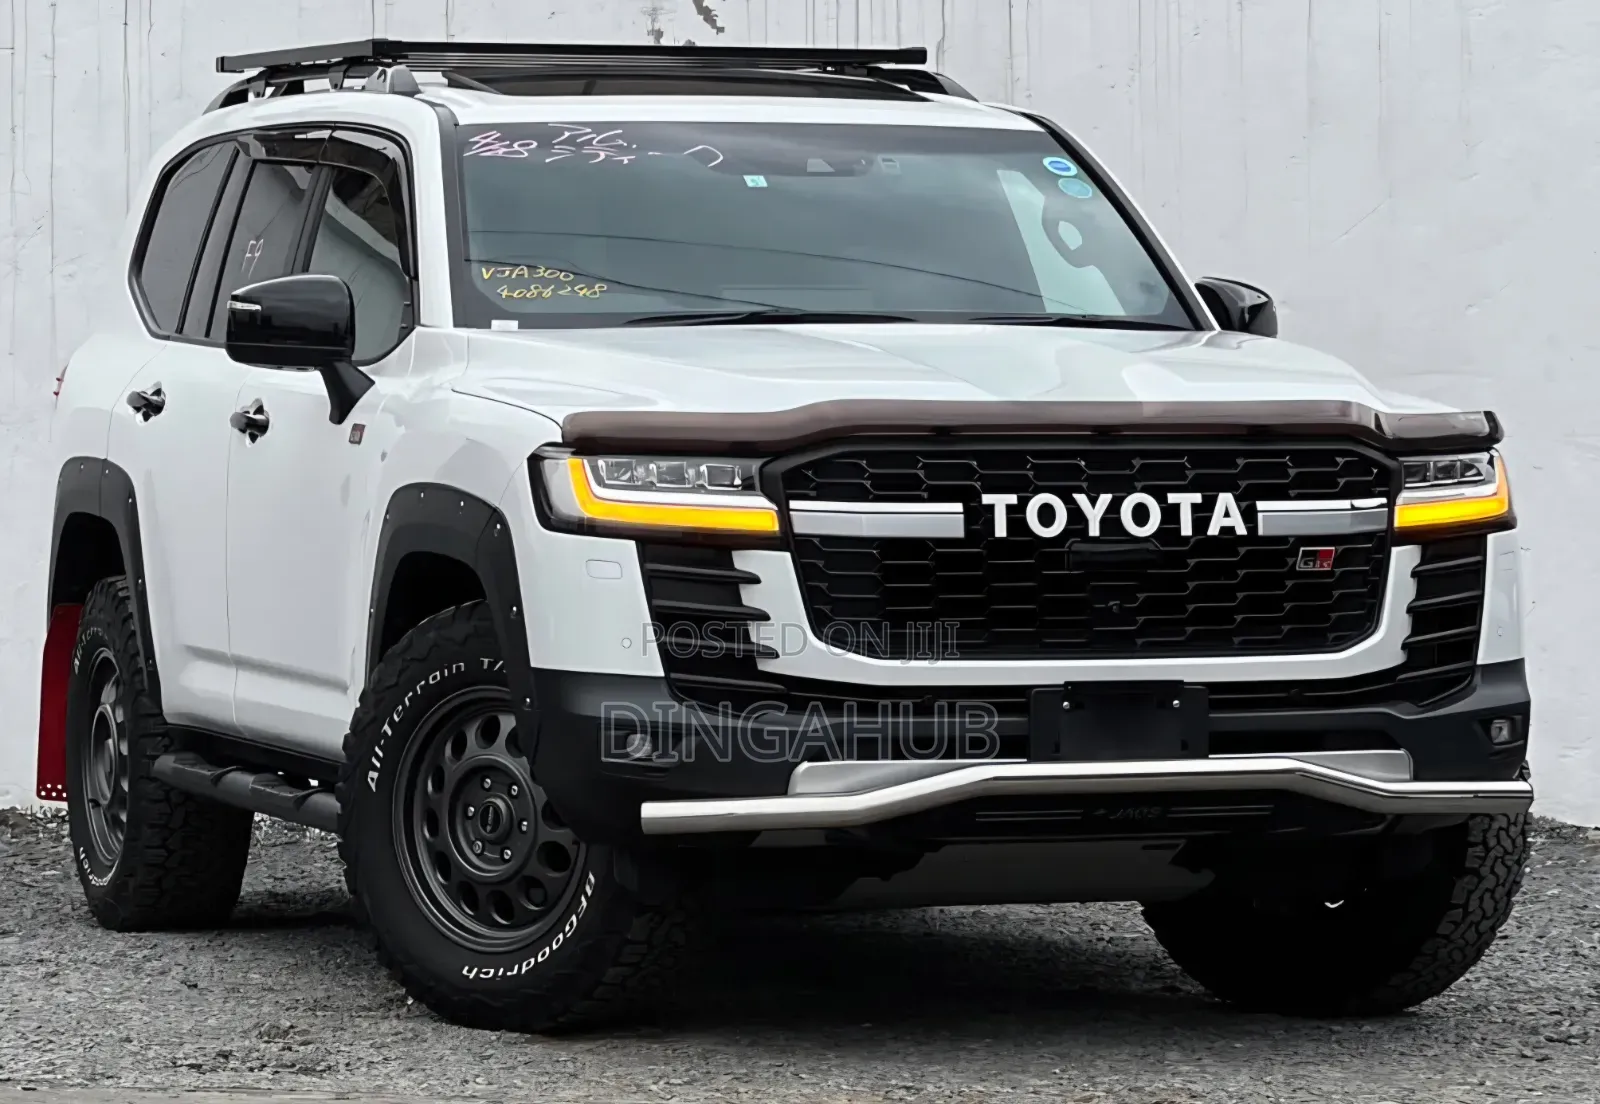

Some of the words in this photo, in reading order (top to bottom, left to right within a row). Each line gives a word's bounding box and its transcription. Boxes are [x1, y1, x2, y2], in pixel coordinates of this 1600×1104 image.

[481, 265, 575, 282] VJA300
[981, 492, 1248, 538] TOYOTA
[367, 662, 466, 793] All-Terrain
[479, 657, 508, 674] T/
[462, 870, 596, 981] BFGoodrich
